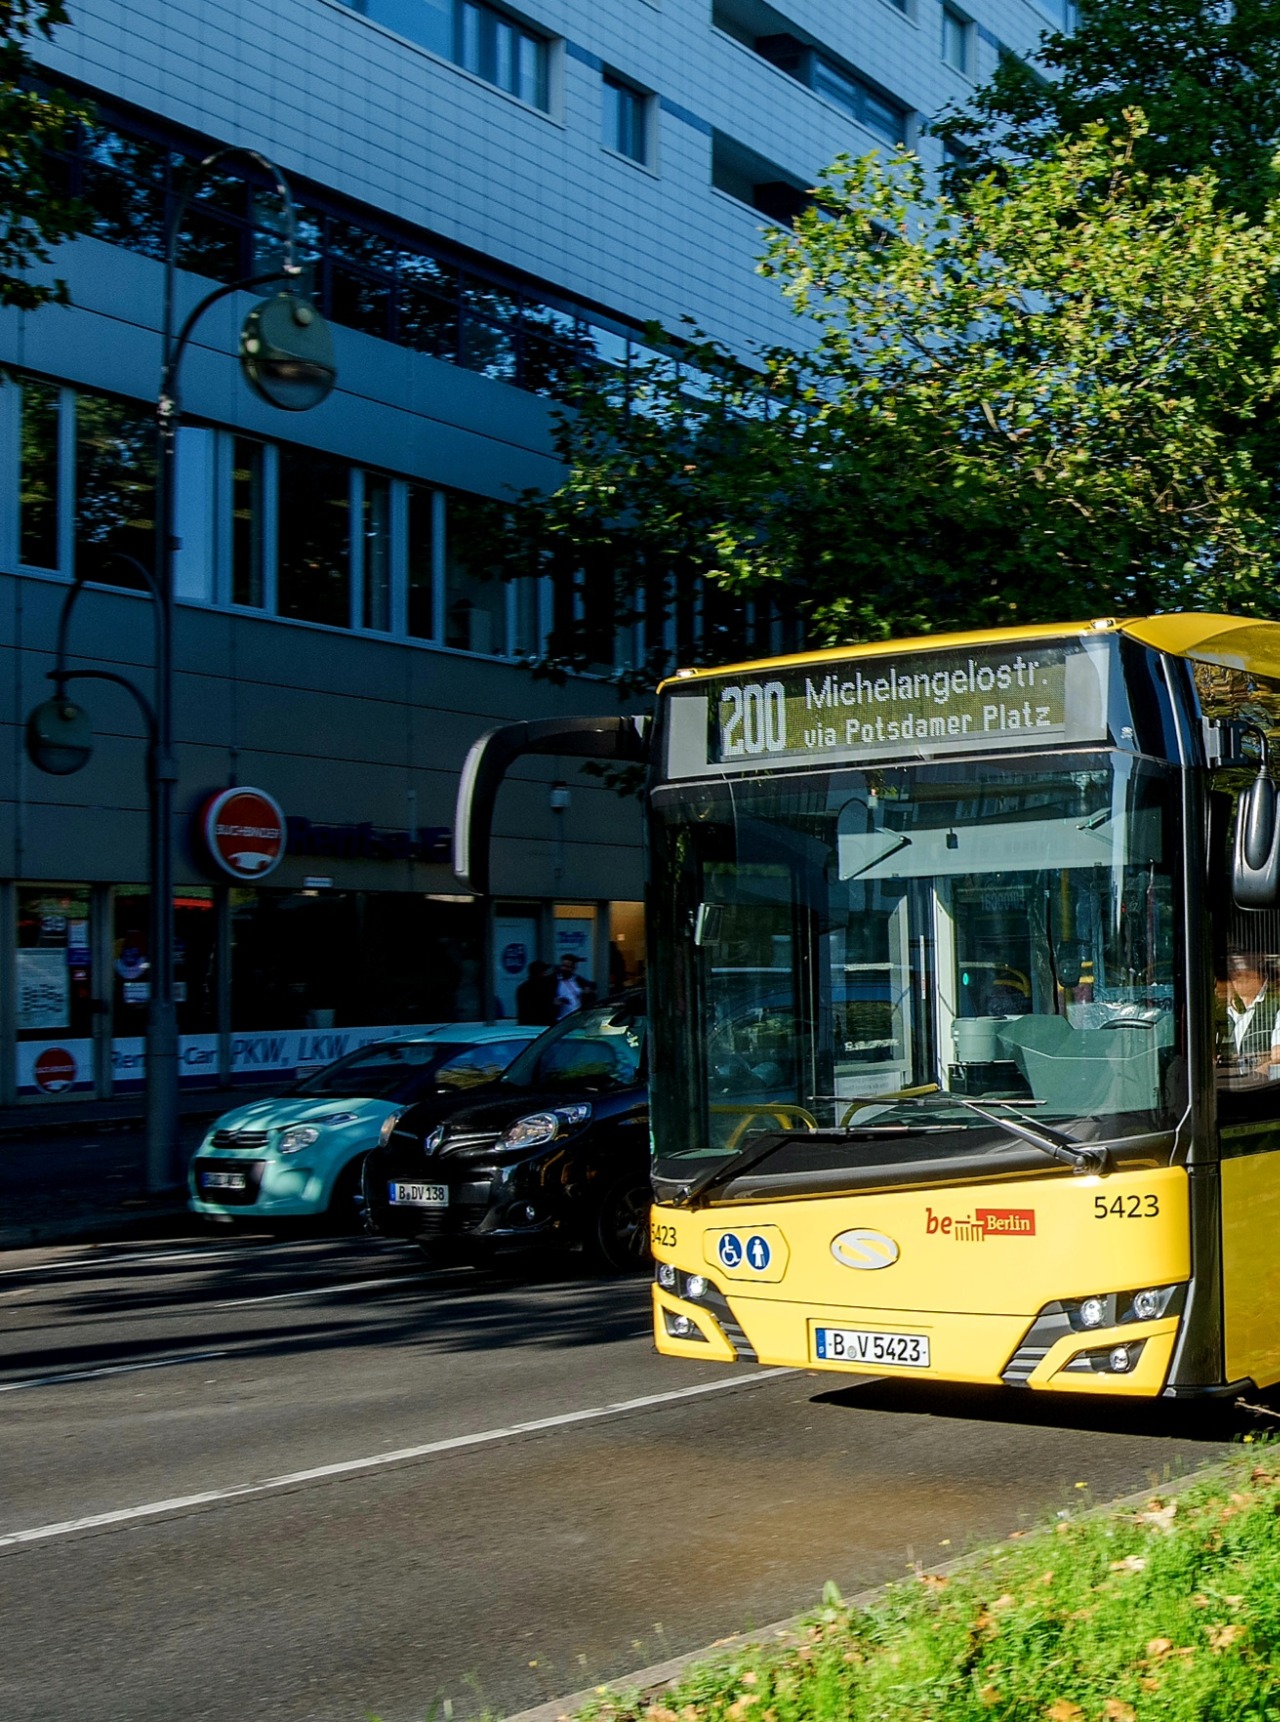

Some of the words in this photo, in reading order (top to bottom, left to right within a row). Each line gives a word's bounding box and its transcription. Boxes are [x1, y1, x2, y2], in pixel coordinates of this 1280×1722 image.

[805, 655, 1048, 709] Michelangelostr.
[721, 681, 787, 756] 200
[804, 723, 837, 748] via
[846, 713, 973, 744] Potsdamer
[983, 702, 1051, 731] Platz
[398, 1185, 406, 1199] B
[411, 1186, 424, 1200] DV
[426, 1186, 445, 1200] 138
[1094, 1195, 1160, 1219] 5423
[925, 1207, 952, 1234] be
[986, 1214, 1031, 1231] Berlin
[833, 1333, 845, 1356] B
[857, 1335, 868, 1358] V
[873, 1336, 920, 1362] 5423
